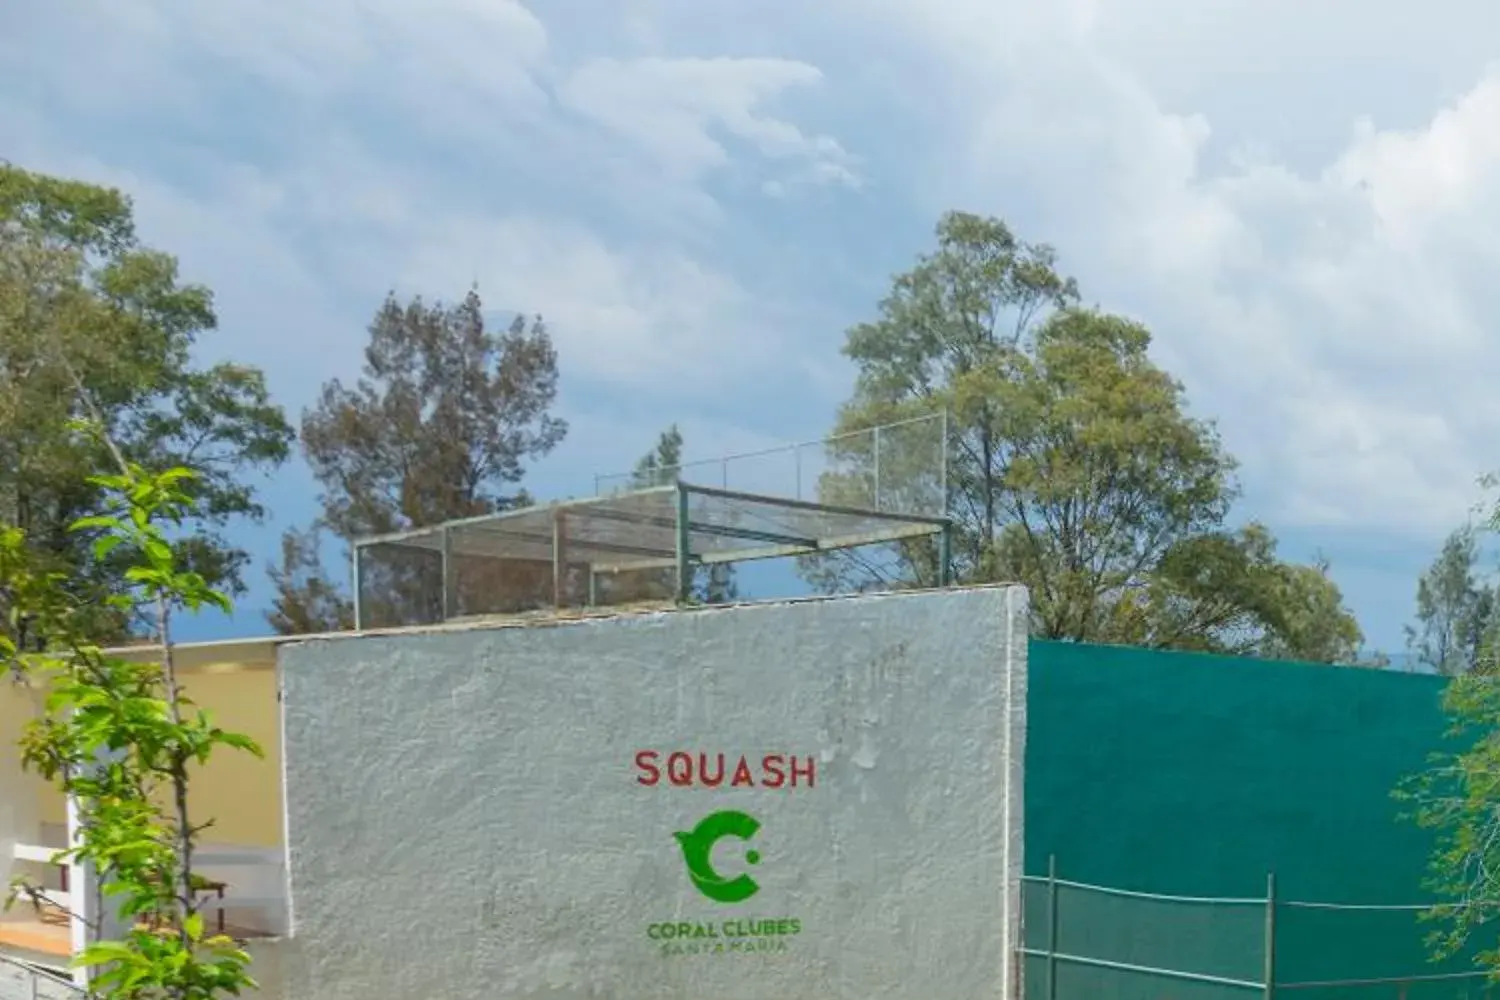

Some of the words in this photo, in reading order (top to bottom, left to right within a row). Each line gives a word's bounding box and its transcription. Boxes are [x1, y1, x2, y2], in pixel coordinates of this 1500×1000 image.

[634, 750, 816, 788] SQUASH
[646, 922, 719, 940] CORAL
[722, 918, 802, 937] CLUBES
